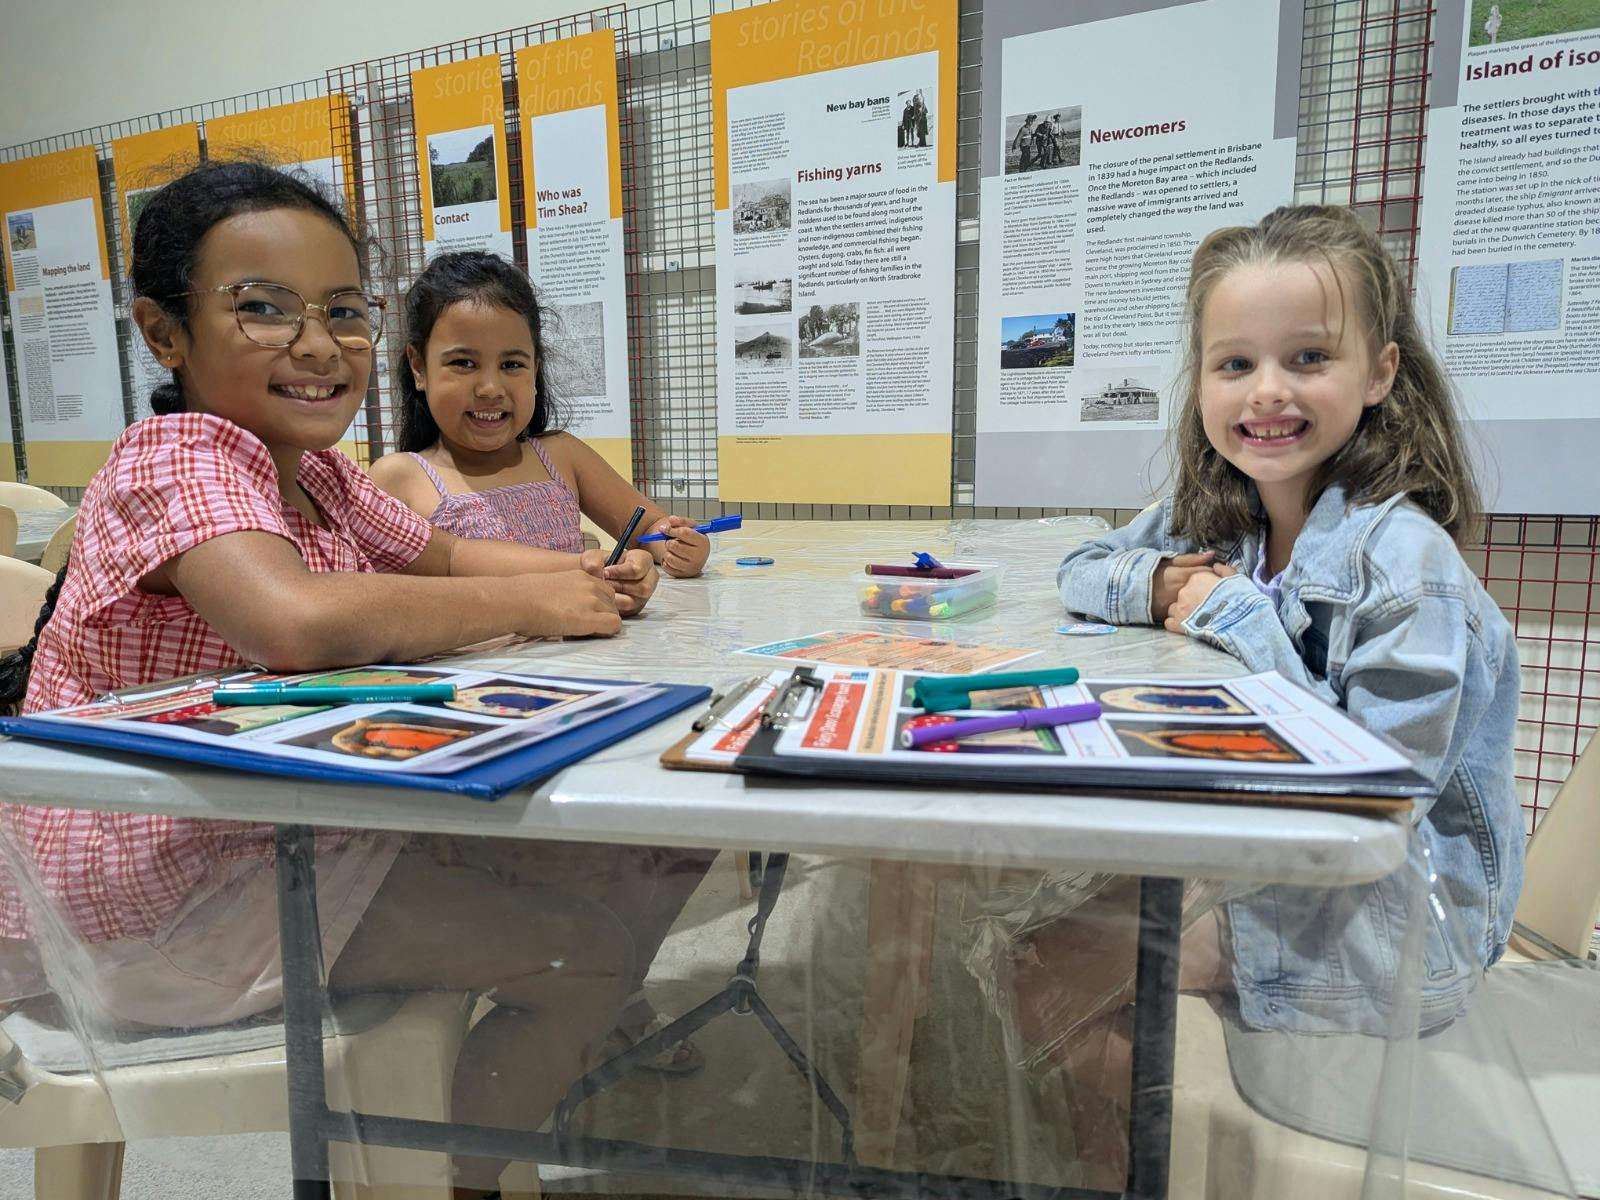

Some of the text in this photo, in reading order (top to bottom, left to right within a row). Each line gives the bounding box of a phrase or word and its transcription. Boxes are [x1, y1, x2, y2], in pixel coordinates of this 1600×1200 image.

[737, 3, 829, 47] stories
[797, 15, 938, 72] Redlands
[526, 47, 551, 81] of
[556, 44, 594, 75] the
[1466, 55, 1533, 80] Island
[1539, 50, 1564, 70] of
[826, 96, 890, 112] New bay bans
[1463, 88, 1591, 112] The settlers brought with
[1461, 101, 1596, 125] diseases. In those days the
[1090, 118, 1186, 144] Newcomers
[1461, 115, 1594, 138] treatment was to separate
[1459, 139, 1498, 150] healthy,
[1514, 134, 1527, 144] all
[1529, 133, 1552, 143] eyes
[1555, 126, 1591, 139] turned
[1097, 171, 1115, 180] 1839
[1116, 169, 1130, 178] had
[1138, 167, 1158, 176] huge
[1159, 163, 1186, 173] impact
[1199, 159, 1213, 167] the
[1214, 154, 1254, 166] Redlands.
[1102, 160, 1129, 169] closure
[1129, 157, 1138, 166] of
[1139, 156, 1151, 164] the
[1152, 152, 1174, 164] penal
[1175, 148, 1217, 160] settlement
[1218, 146, 1226, 154] in
[1227, 143, 1262, 153] Brisbane
[1458, 158, 1472, 166] The
[1497, 152, 1526, 163] already
[1527, 149, 1543, 158] had
[1544, 146, 1581, 157] buildings
[797, 161, 882, 183] Fishing yarns
[1087, 184, 1106, 192] Once
[1121, 178, 1154, 188] Moreton
[1155, 176, 1170, 184] Bay
[1170, 174, 1188, 182] area
[1195, 169, 1220, 179] which
[1221, 164, 1256, 176] included
[1478, 176, 1494, 184] into
[1495, 174, 1517, 182] being
[1518, 172, 1526, 180] in
[1529, 170, 1549, 179] 1850.
[537, 188, 582, 202] Who was
[849, 192, 867, 201] major
[867, 190, 887, 198] source
[895, 186, 910, 194] food
[917, 184, 928, 192] the
[1087, 194, 1100, 202] the
[1100, 190, 1134, 201] Redlands
[1158, 183, 1188, 195] opened
[1199, 180, 1231, 189] settlers,
[1087, 204, 1116, 213] massive
[1137, 199, 1146, 207] of
[1147, 195, 1191, 206] immigrants
[1192, 190, 1220, 201] arrived
[1222, 188, 1238, 198] and
[537, 201, 588, 219] Tim Shea?
[798, 196, 917, 215] Redlands for thousands of years, and huge
[798, 216, 821, 225] middens
[822, 214, 836, 222] used
[852, 210, 870, 218] found
[870, 209, 888, 217] along
[904, 205, 911, 213] of
[1086, 200, 1244, 223] completely changed the way the land was
[434, 212, 470, 225] Contact
[1086, 224, 1106, 234] used.
[1452, 248, 1466, 256] had
[1488, 244, 1512, 253] buried
[1523, 242, 1536, 250] the
[1537, 240, 1576, 249] cemetery.
[42, 262, 91, 277] Mapping the land
[798, 289, 816, 297] Island.
